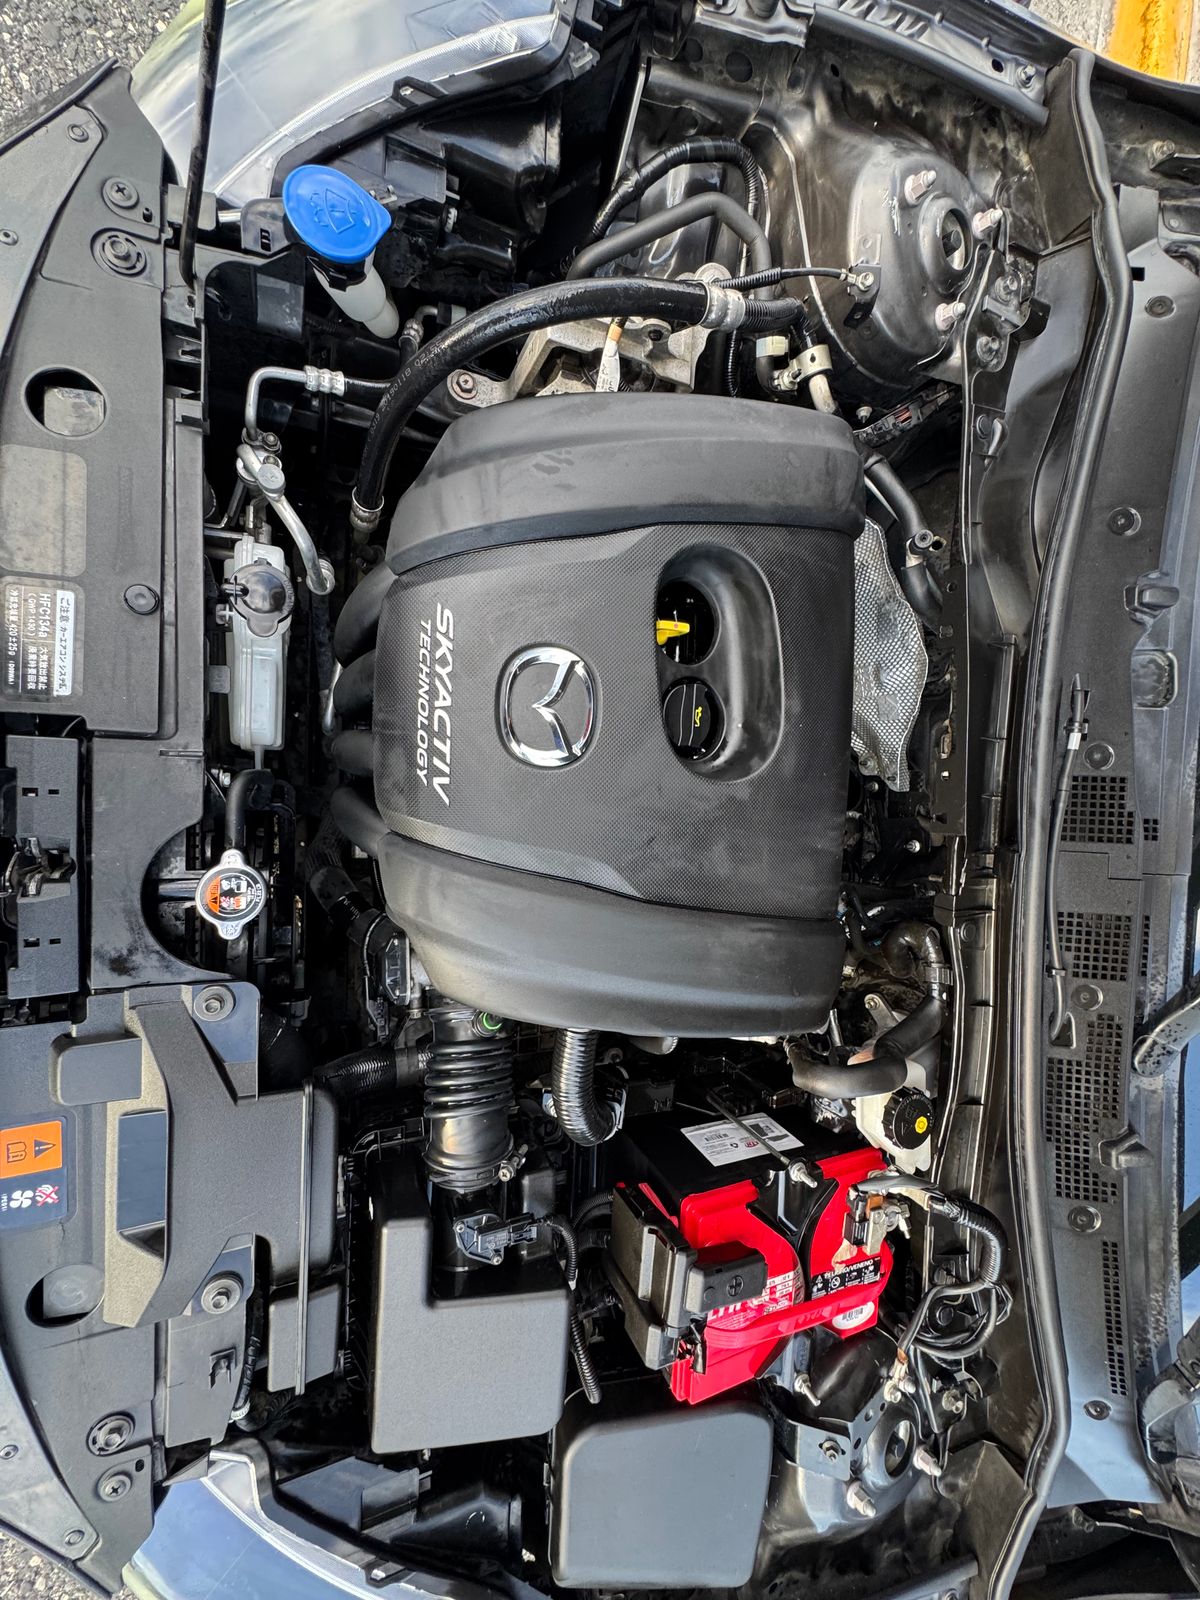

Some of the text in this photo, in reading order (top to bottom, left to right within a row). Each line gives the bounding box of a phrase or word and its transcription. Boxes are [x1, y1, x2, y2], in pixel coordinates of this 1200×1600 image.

[38, 593, 51, 638] HFC134a
[59, 597, 70, 623] ご注意
[416, 619, 431, 787] TECHNOLOGY
[433, 602, 454, 807] SKYACTIV
